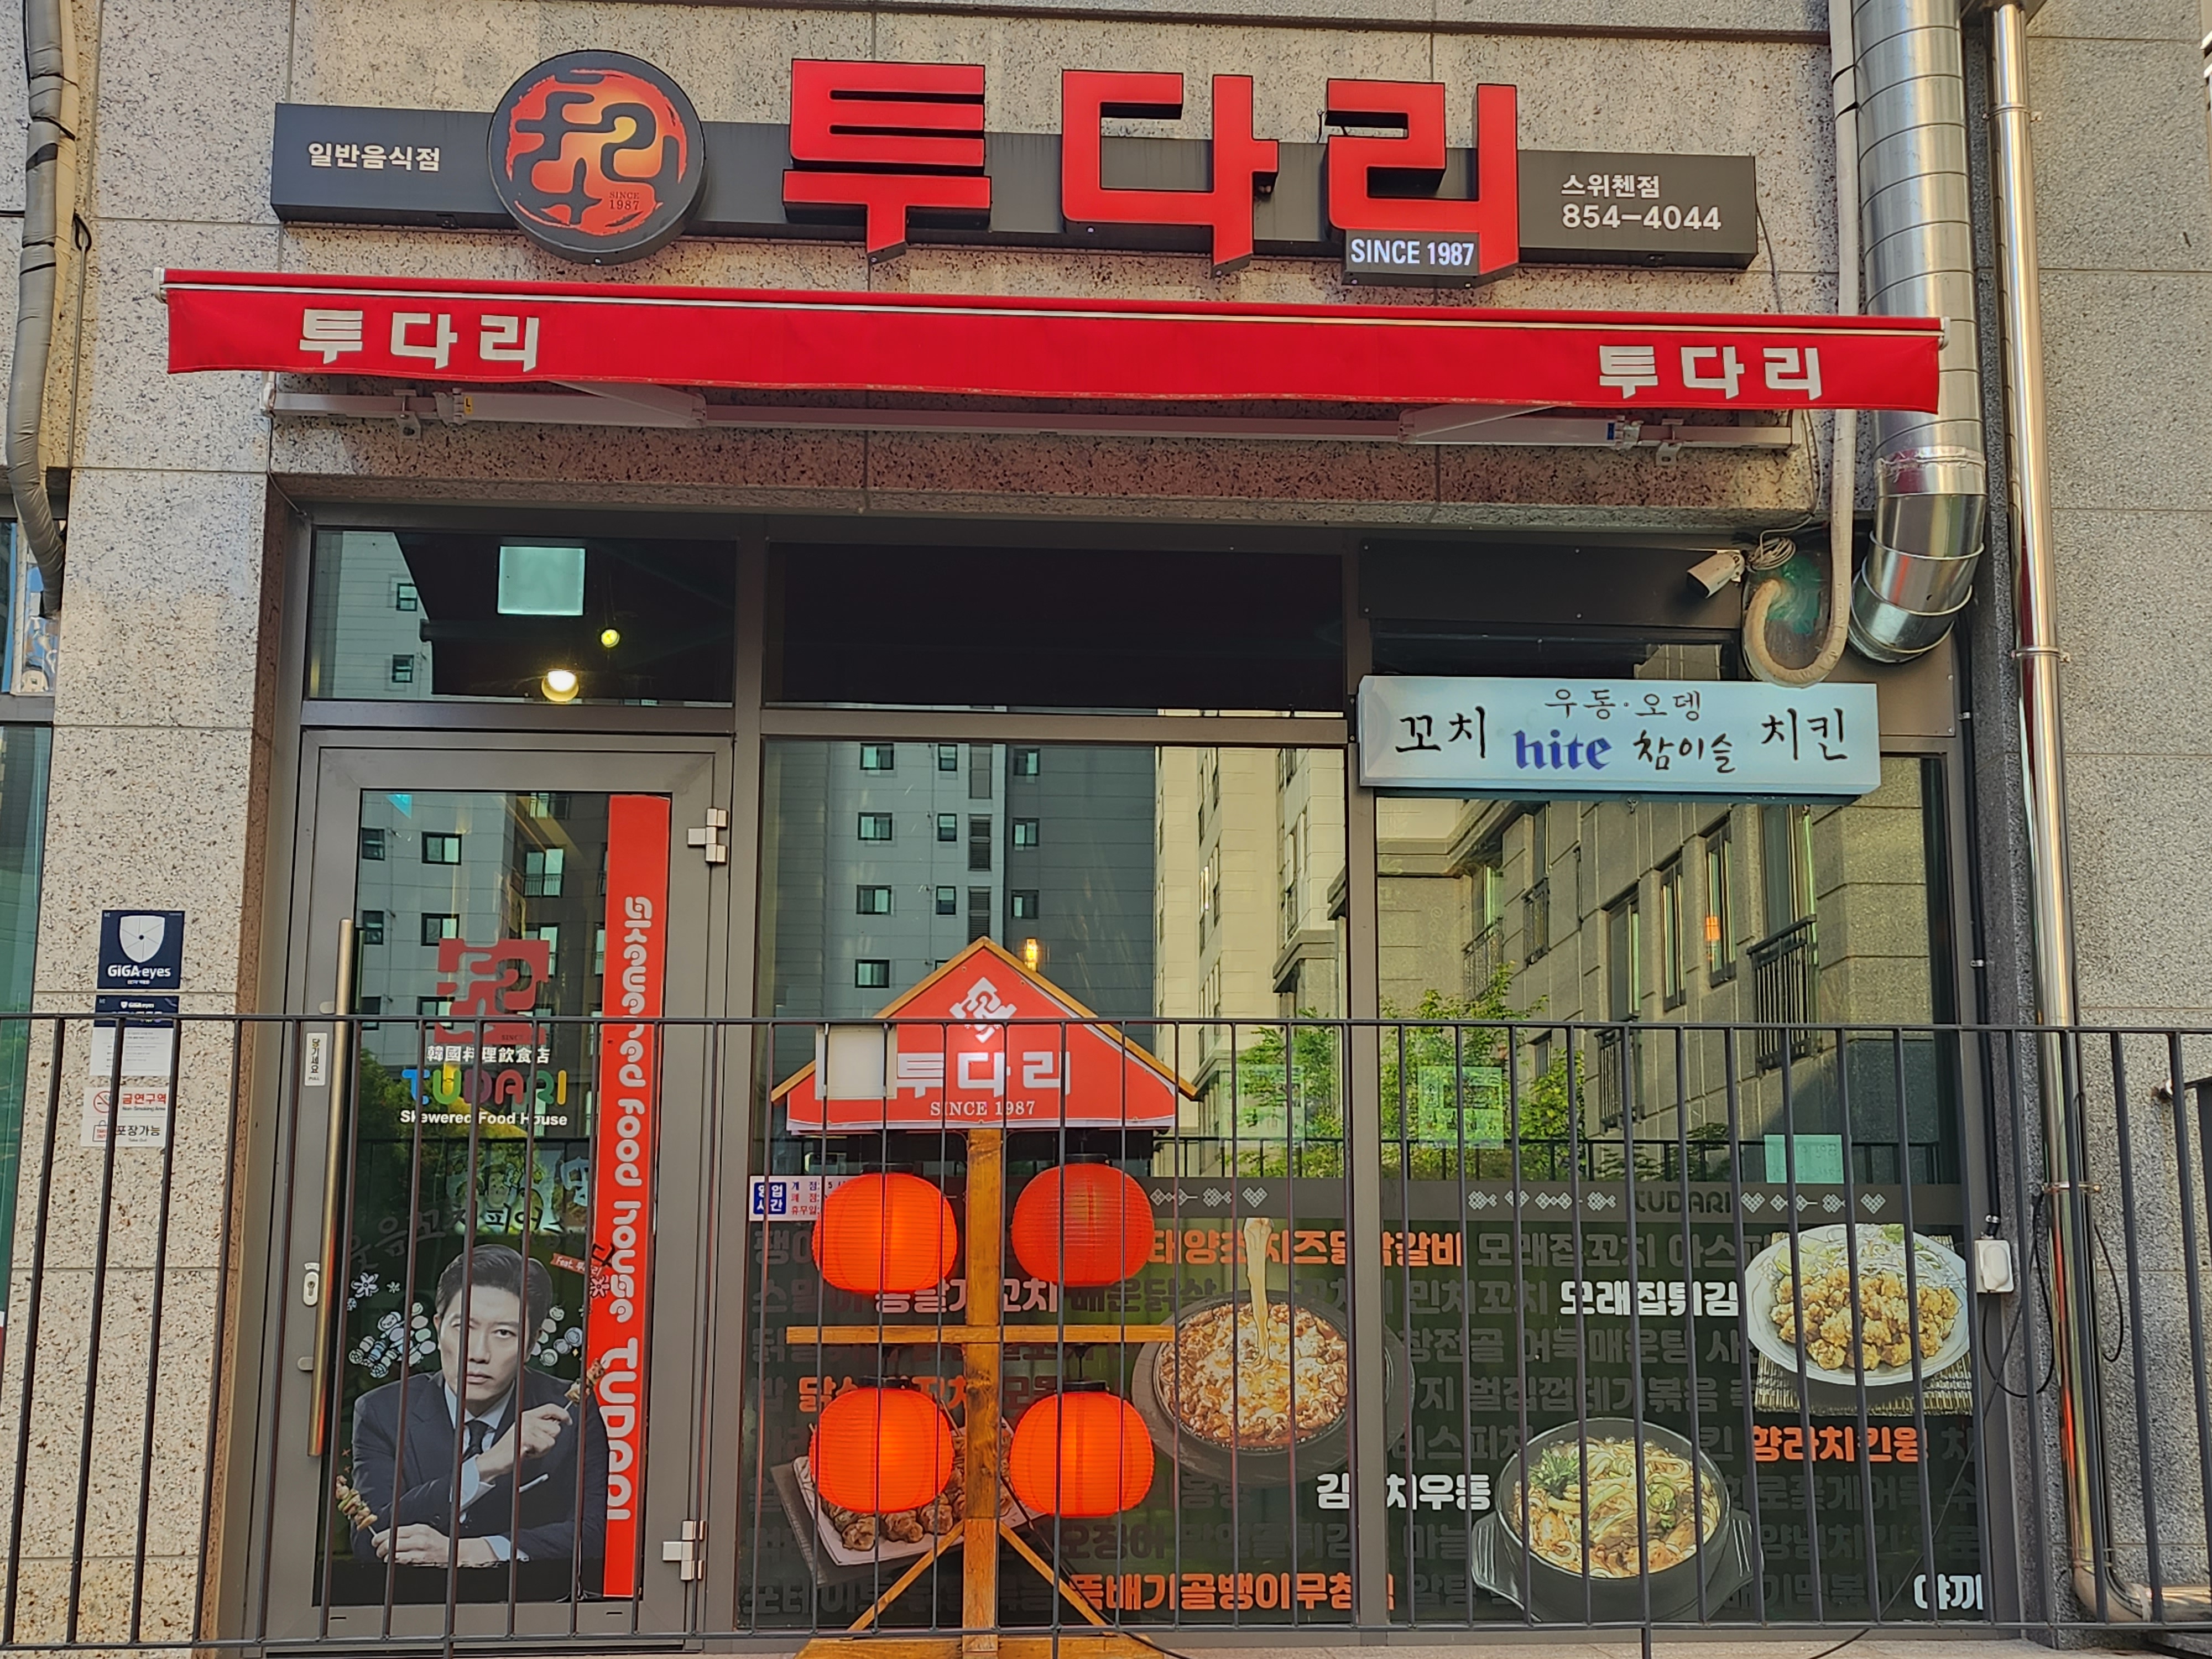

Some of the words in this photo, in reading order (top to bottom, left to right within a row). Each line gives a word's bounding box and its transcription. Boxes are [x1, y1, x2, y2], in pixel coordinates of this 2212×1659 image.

[308, 142, 440, 171] 일반음식점
[782, 59, 1517, 274] 투다리
[609, 191, 639, 200] SINCE
[1561, 174, 1661, 198] 스위첸점
[609, 200, 639, 211] 1987
[1562, 204, 1721, 231] 854-4044
[1350, 238, 1420, 264] SINCE
[1426, 241, 1474, 267] 1987
[299, 309, 540, 373] 투다리
[1599, 345, 1823, 401] 투다리
[1395, 705, 1486, 759] 꼬치
[1513, 729, 1613, 771] hite
[1633, 730, 1736, 774] 참이슬
[1761, 707, 1849, 761] 치킨
[310, 1038, 321, 1074] 당기세요
[401, 1069, 567, 1105] TUDARI
[898, 1051, 1071, 1098] 투다리
[122, 1093, 166, 1105] 금연구역
[930, 1101, 987, 1116] SINCE
[995, 1100, 1035, 1116] 1987
[116, 1125, 161, 1136] 포장가능
[479, 1111, 515, 1125] Food
[758, 1184, 783, 1197] 영업
[1634, 1190, 1731, 1214] TUDARI
[1477, 1233, 1656, 1268] 모래집꼬치
[1560, 1281, 1739, 1317] 모래집튀김
[1317, 1472, 1491, 1510] 김치우동
